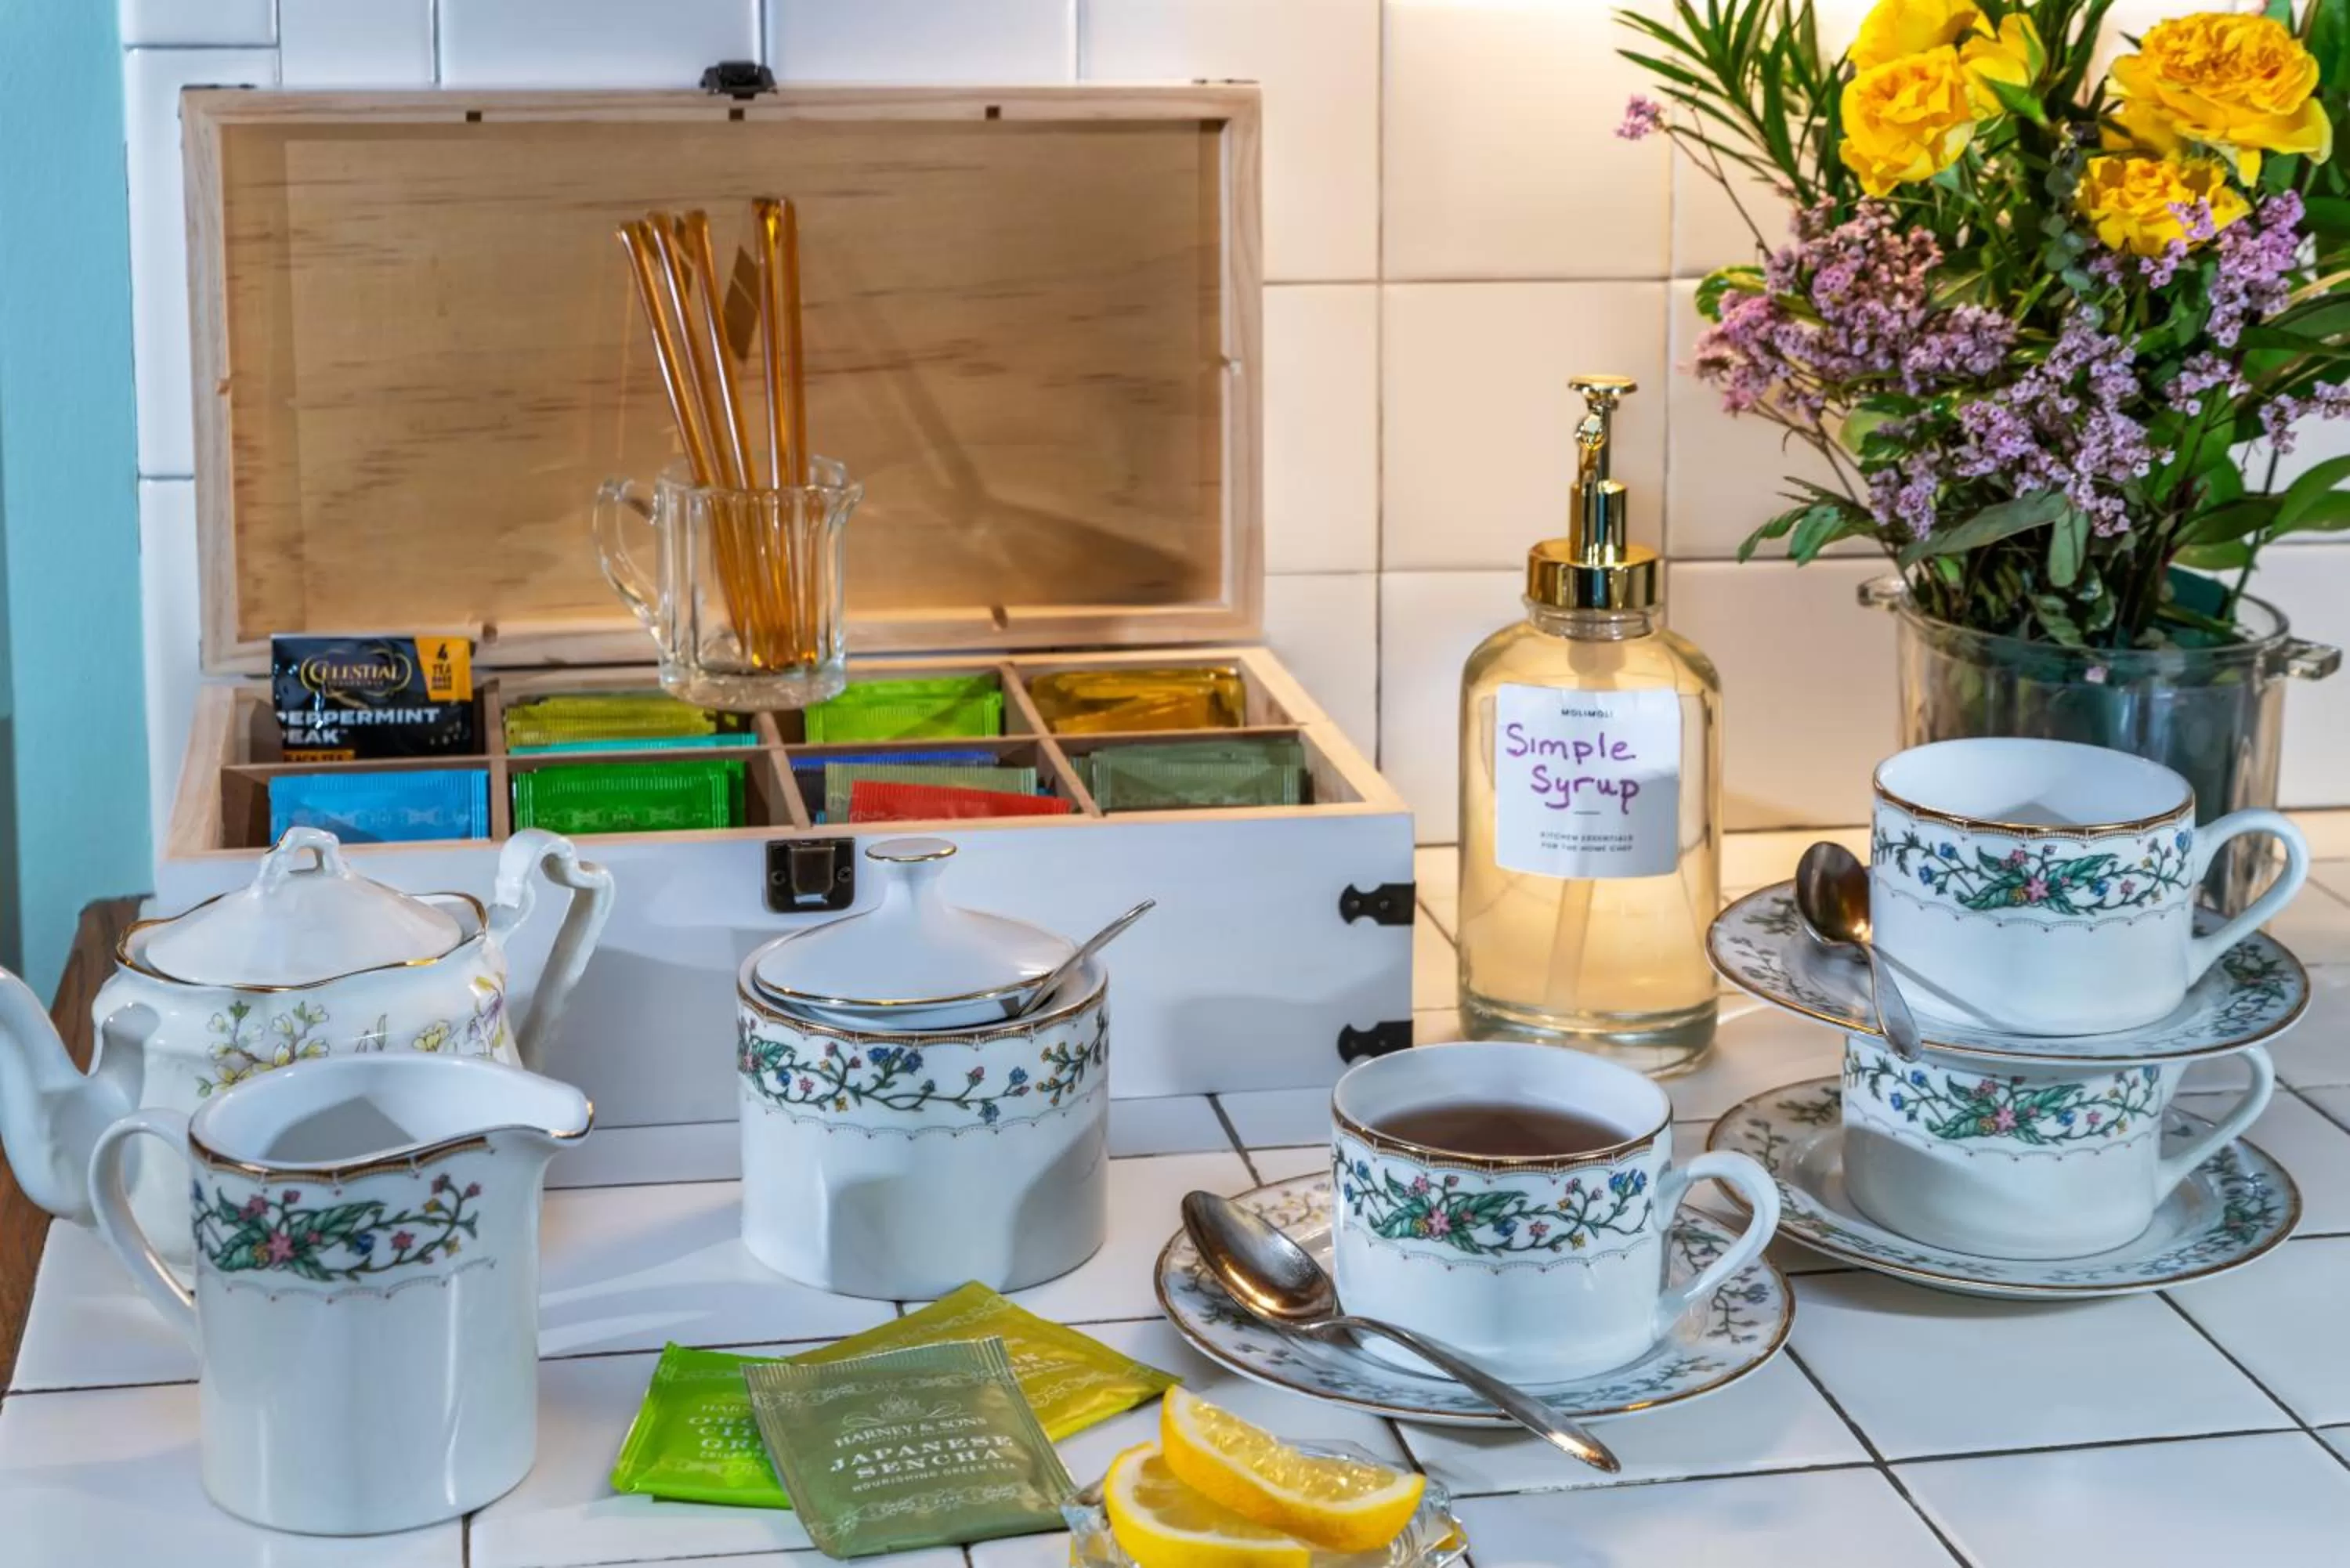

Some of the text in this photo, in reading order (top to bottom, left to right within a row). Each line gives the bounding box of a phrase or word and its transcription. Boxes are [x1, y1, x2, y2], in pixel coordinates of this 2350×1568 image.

[309, 659, 396, 684] CELESTIAL
[1506, 722, 1636, 765] Simple
[1530, 764, 1640, 815] Syrup
[834, 1424, 913, 1447] HARNEY
[938, 1417, 988, 1430] SONS
[830, 1435, 1014, 1473] JAPANESE
[855, 1448, 1002, 1479] SENCHA
